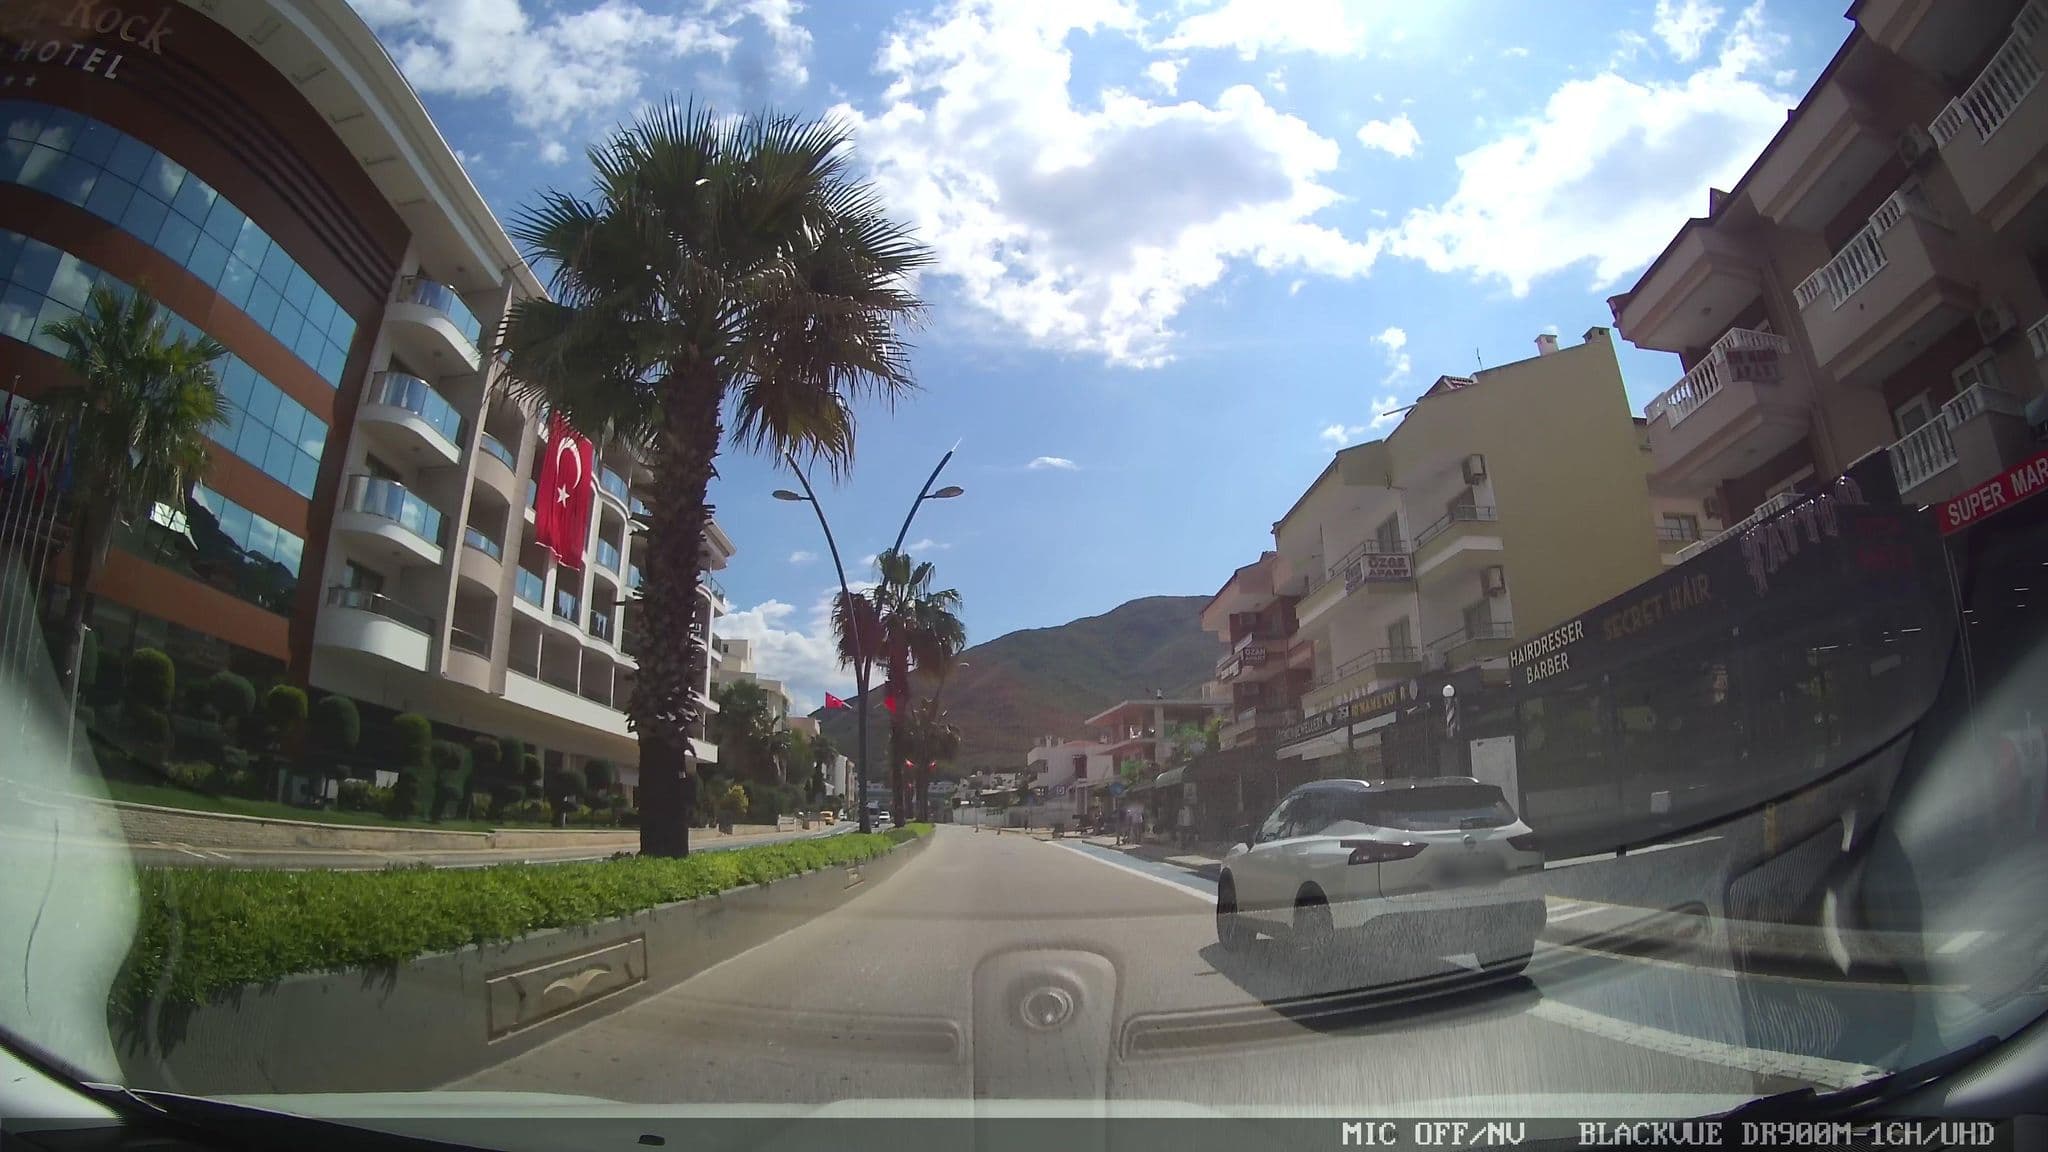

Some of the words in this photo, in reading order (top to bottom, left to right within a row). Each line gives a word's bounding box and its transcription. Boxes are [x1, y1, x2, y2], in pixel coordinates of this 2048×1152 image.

[14, 39, 124, 80] HOTEL
[1947, 481, 2007, 526] SUPER
[1602, 595, 1665, 641] SECRET
[1668, 573, 1713, 612] HAIR
[1509, 619, 1585, 669] HAIRDRESSER
[1525, 651, 1570, 685] BARBER
